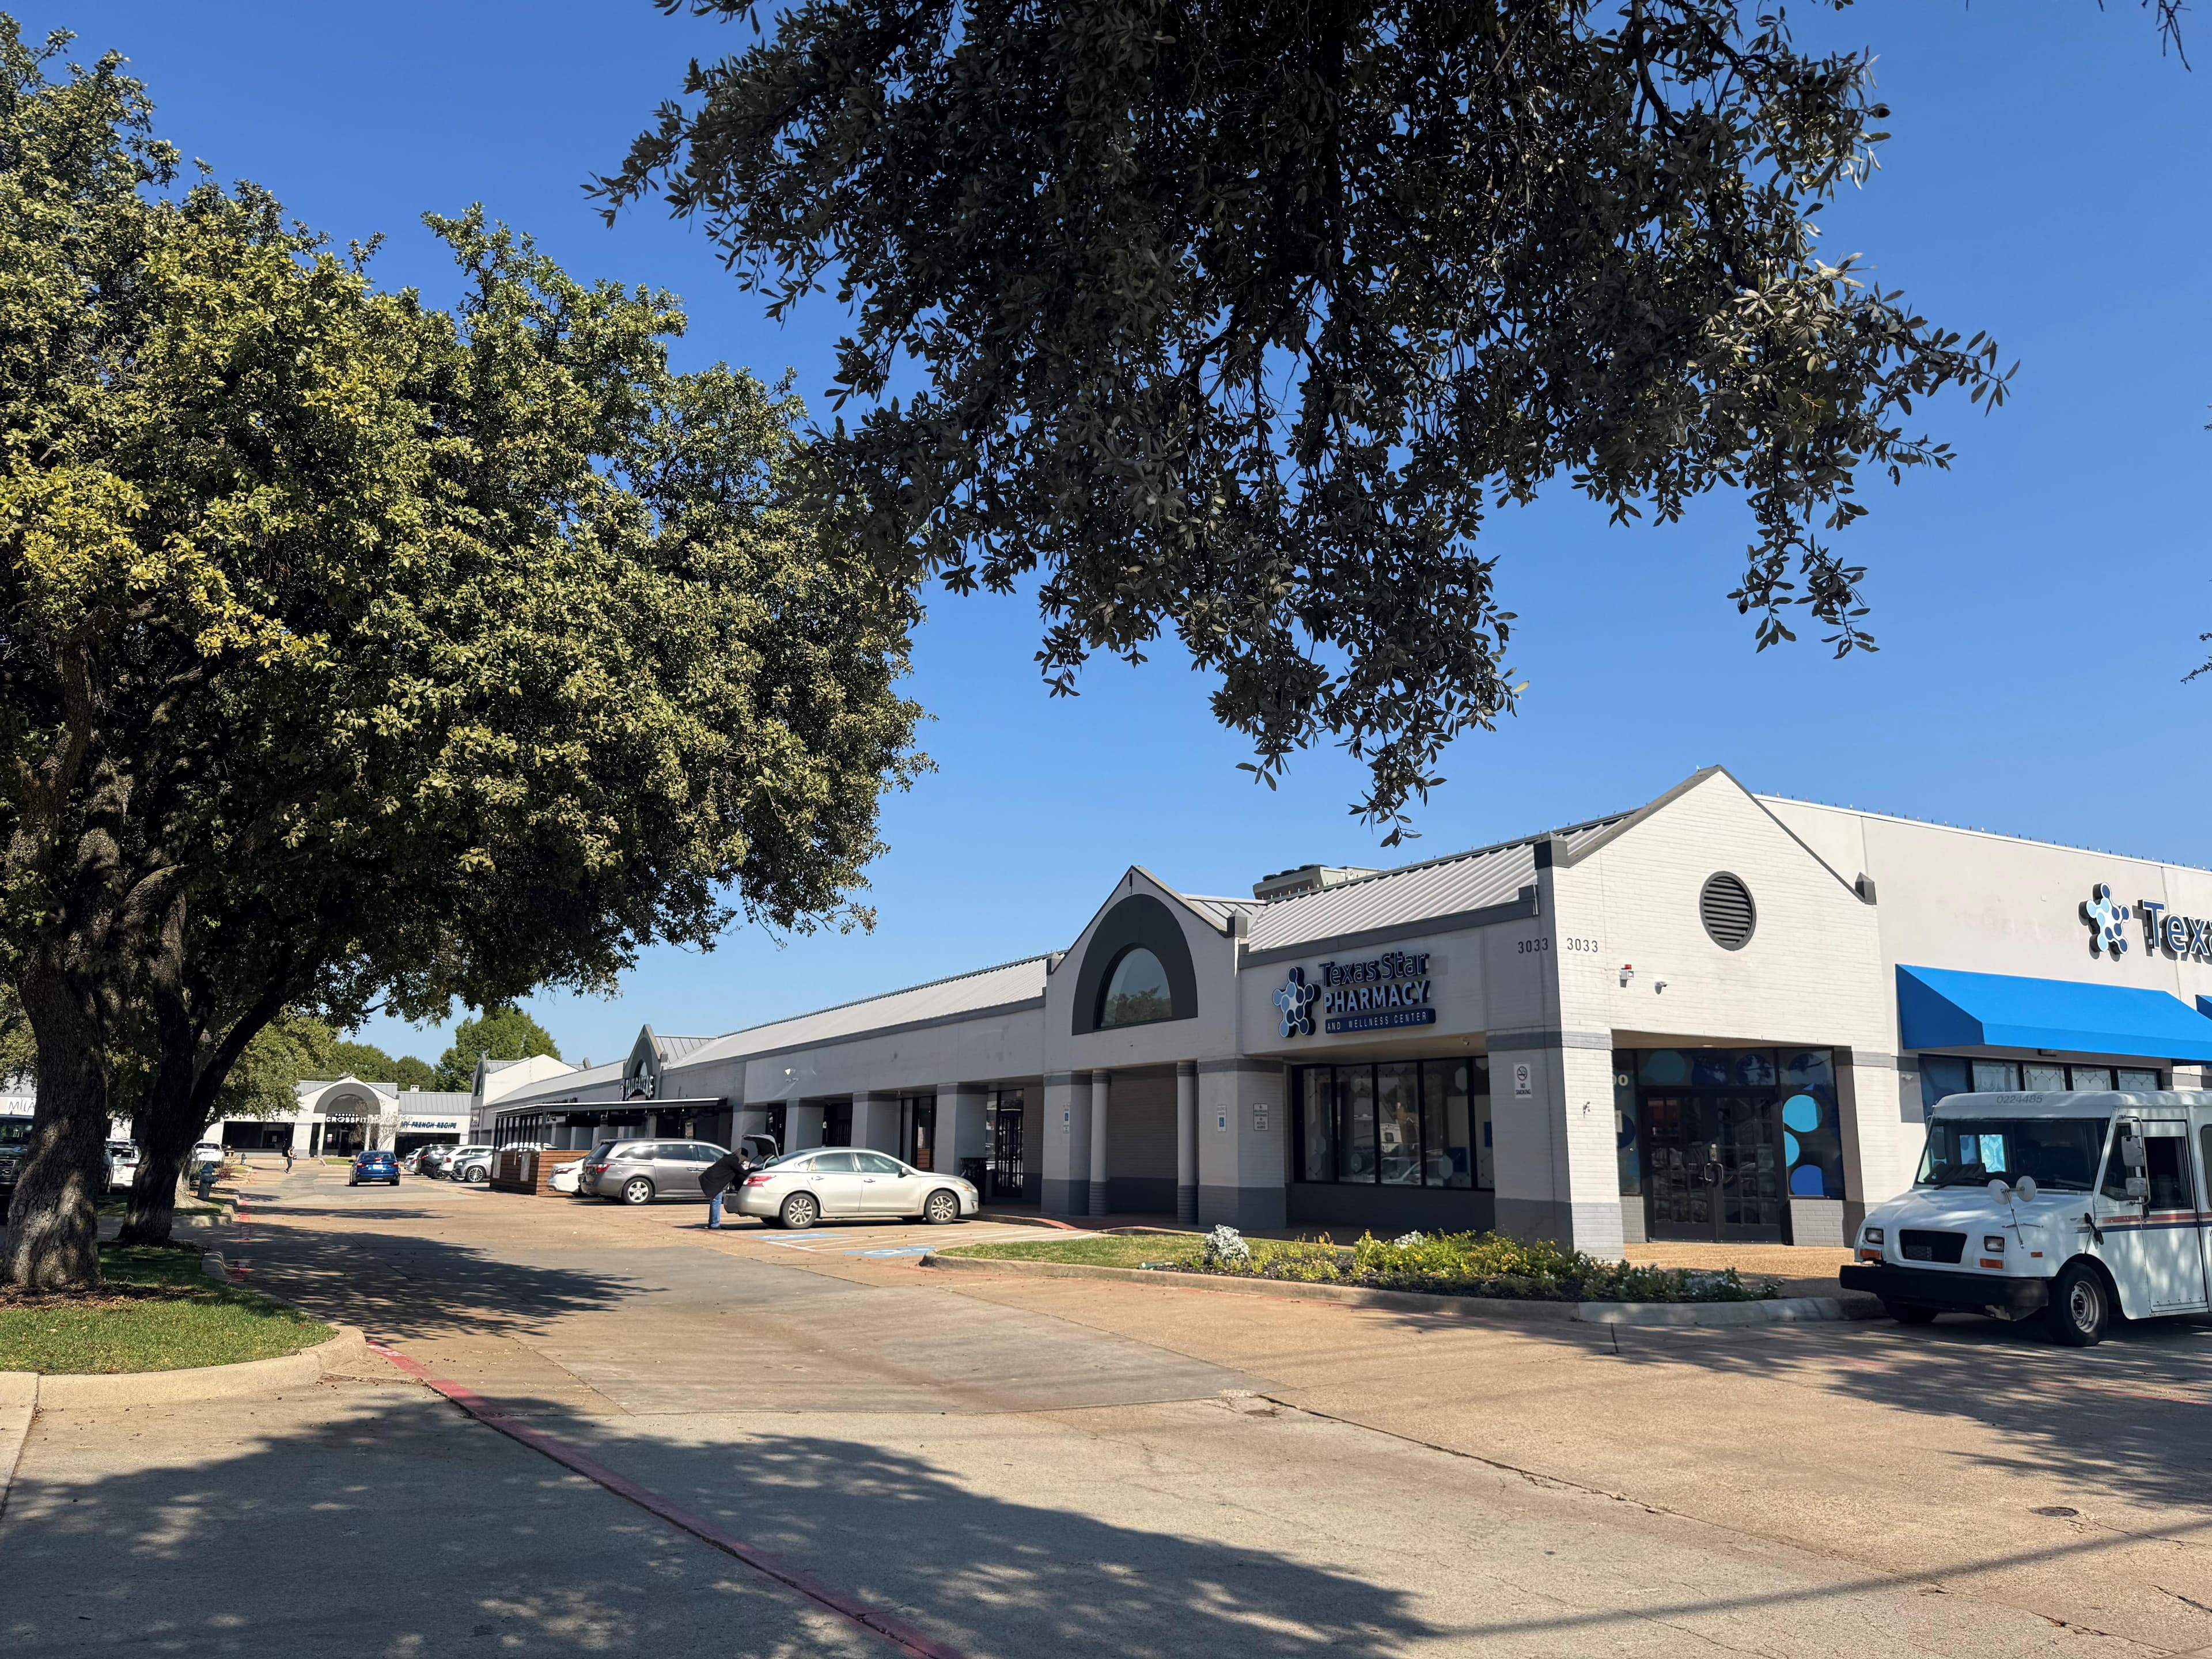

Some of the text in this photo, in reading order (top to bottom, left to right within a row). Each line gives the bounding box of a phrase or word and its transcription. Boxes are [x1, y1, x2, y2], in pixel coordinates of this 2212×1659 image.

[2141, 899, 2212, 956] Tex
[1518, 938, 1548, 954] 3033
[1566, 938, 1598, 953] 3033
[1318, 951, 1427, 987] Texas Star
[1324, 980, 1427, 1014] PHARMACY
[1327, 1011, 1427, 1031] AND WELLNESS CENTER
[1996, 1094, 2043, 1104] 0224485
[411, 1121, 435, 1129] FRENCH
